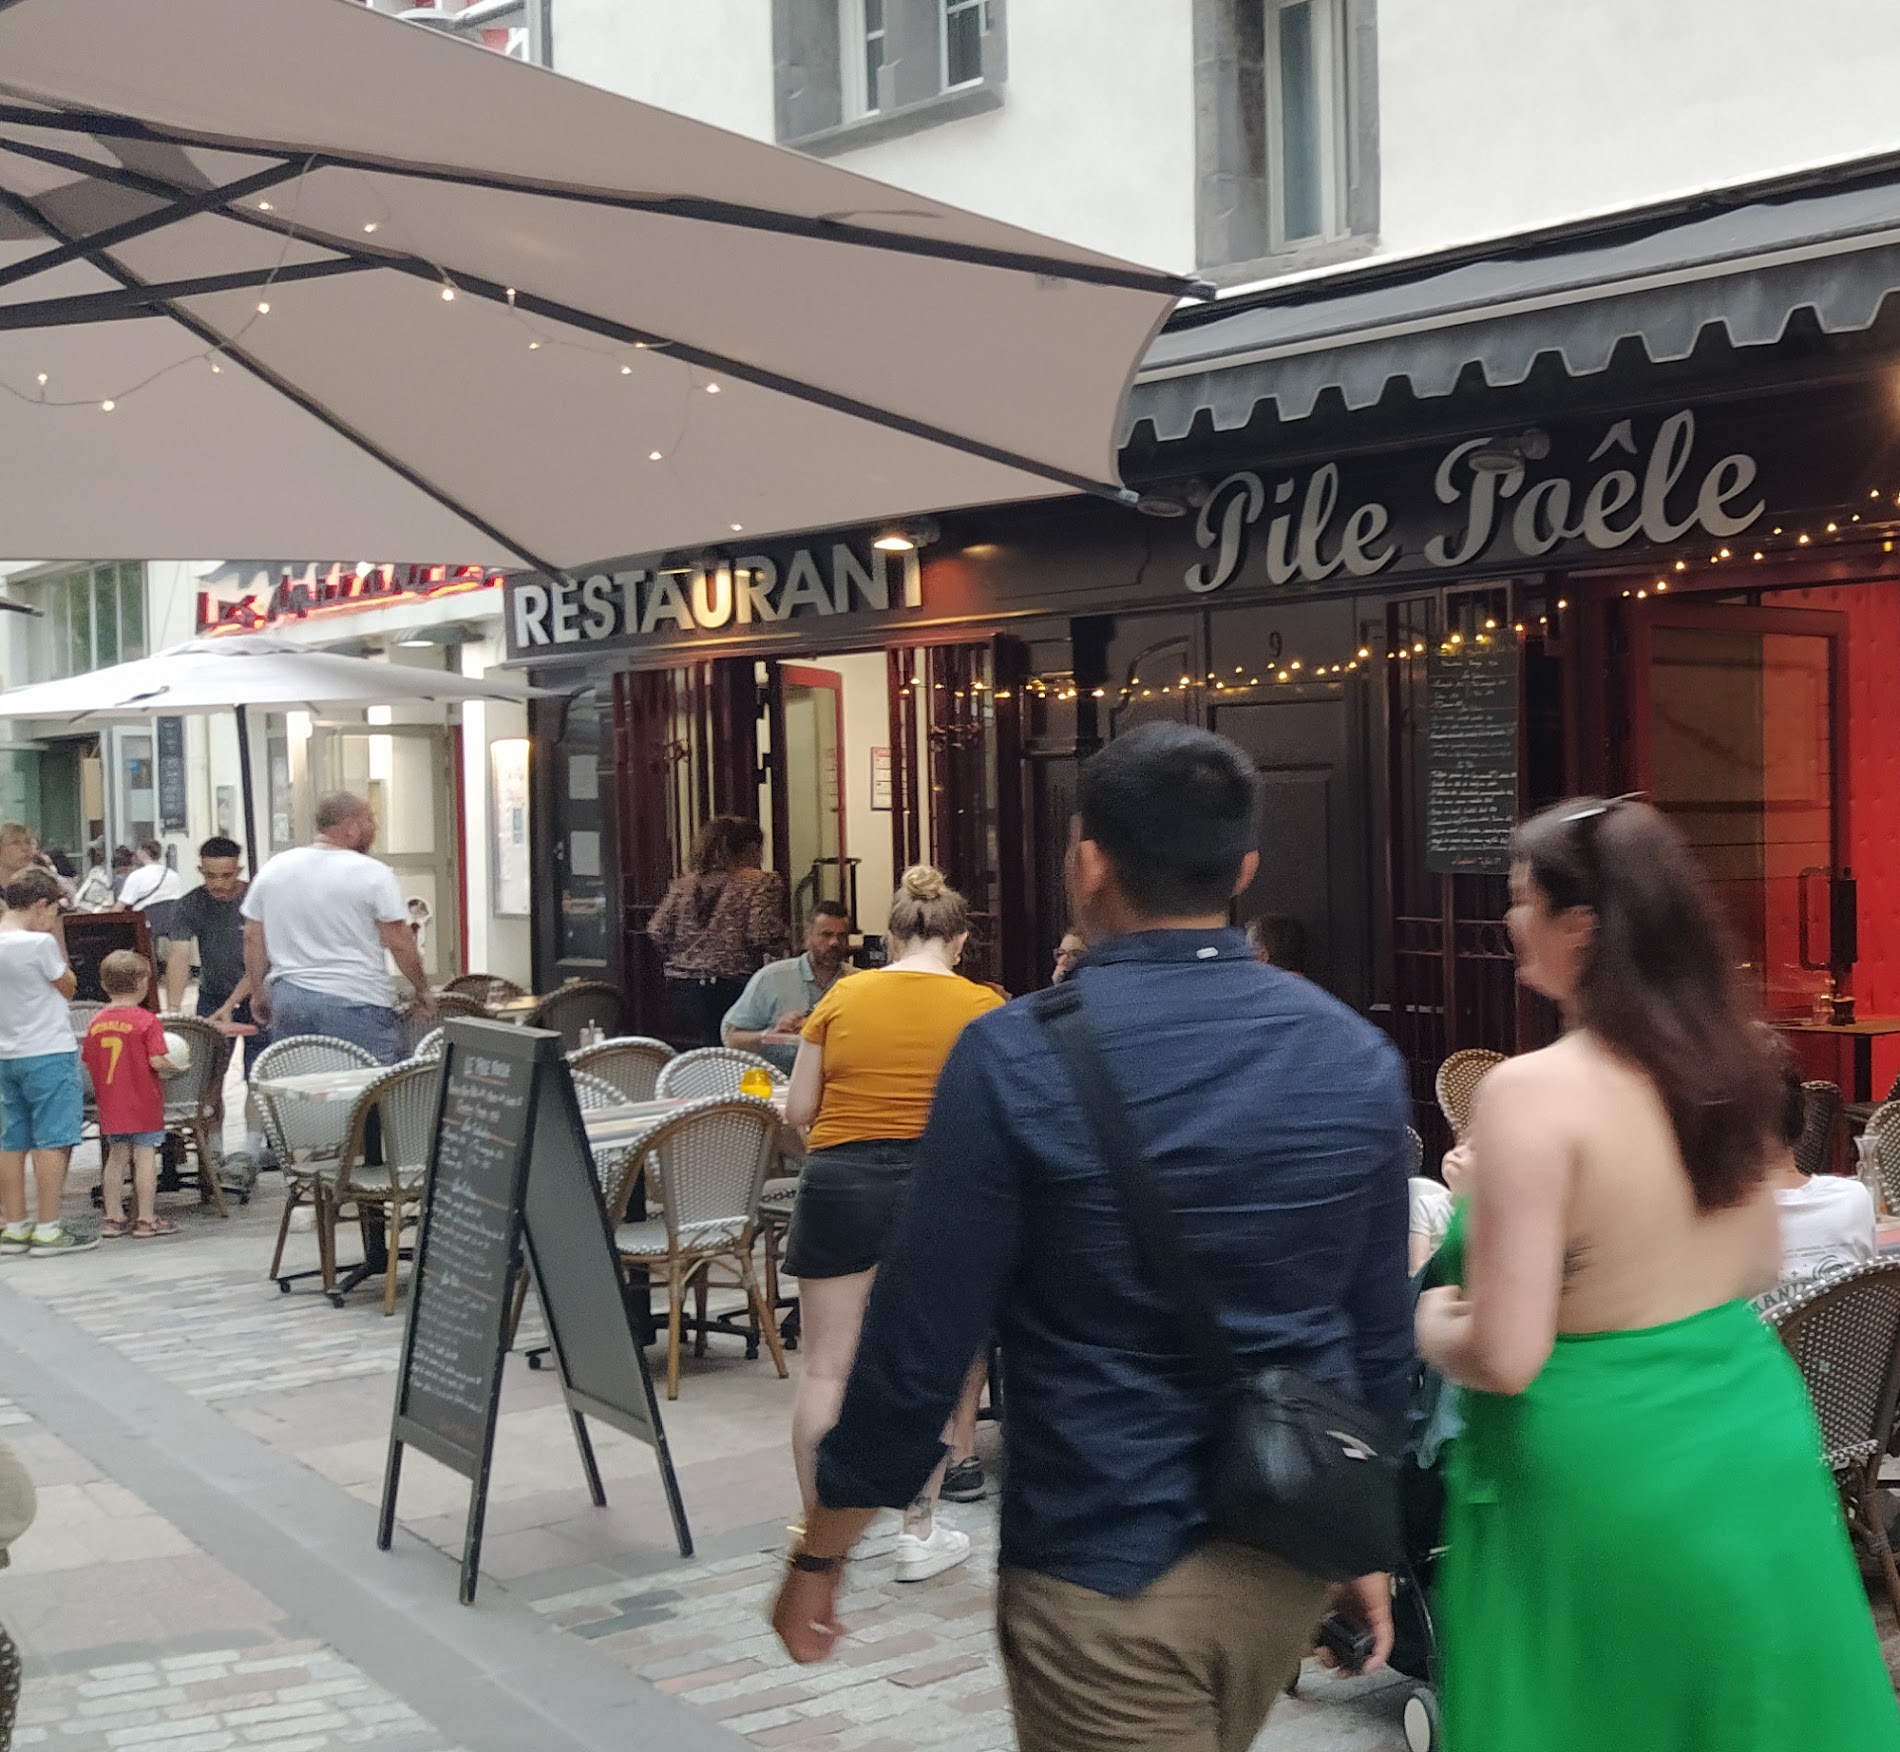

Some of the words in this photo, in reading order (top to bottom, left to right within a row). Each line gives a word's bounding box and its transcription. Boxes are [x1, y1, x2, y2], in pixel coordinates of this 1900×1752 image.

[1184, 463, 1401, 592] Pile
[1423, 408, 1767, 567] Poêle
[513, 543, 923, 648] RESTAURANT
[1269, 631, 1282, 658] 9
[100, 1036, 123, 1085] 7
